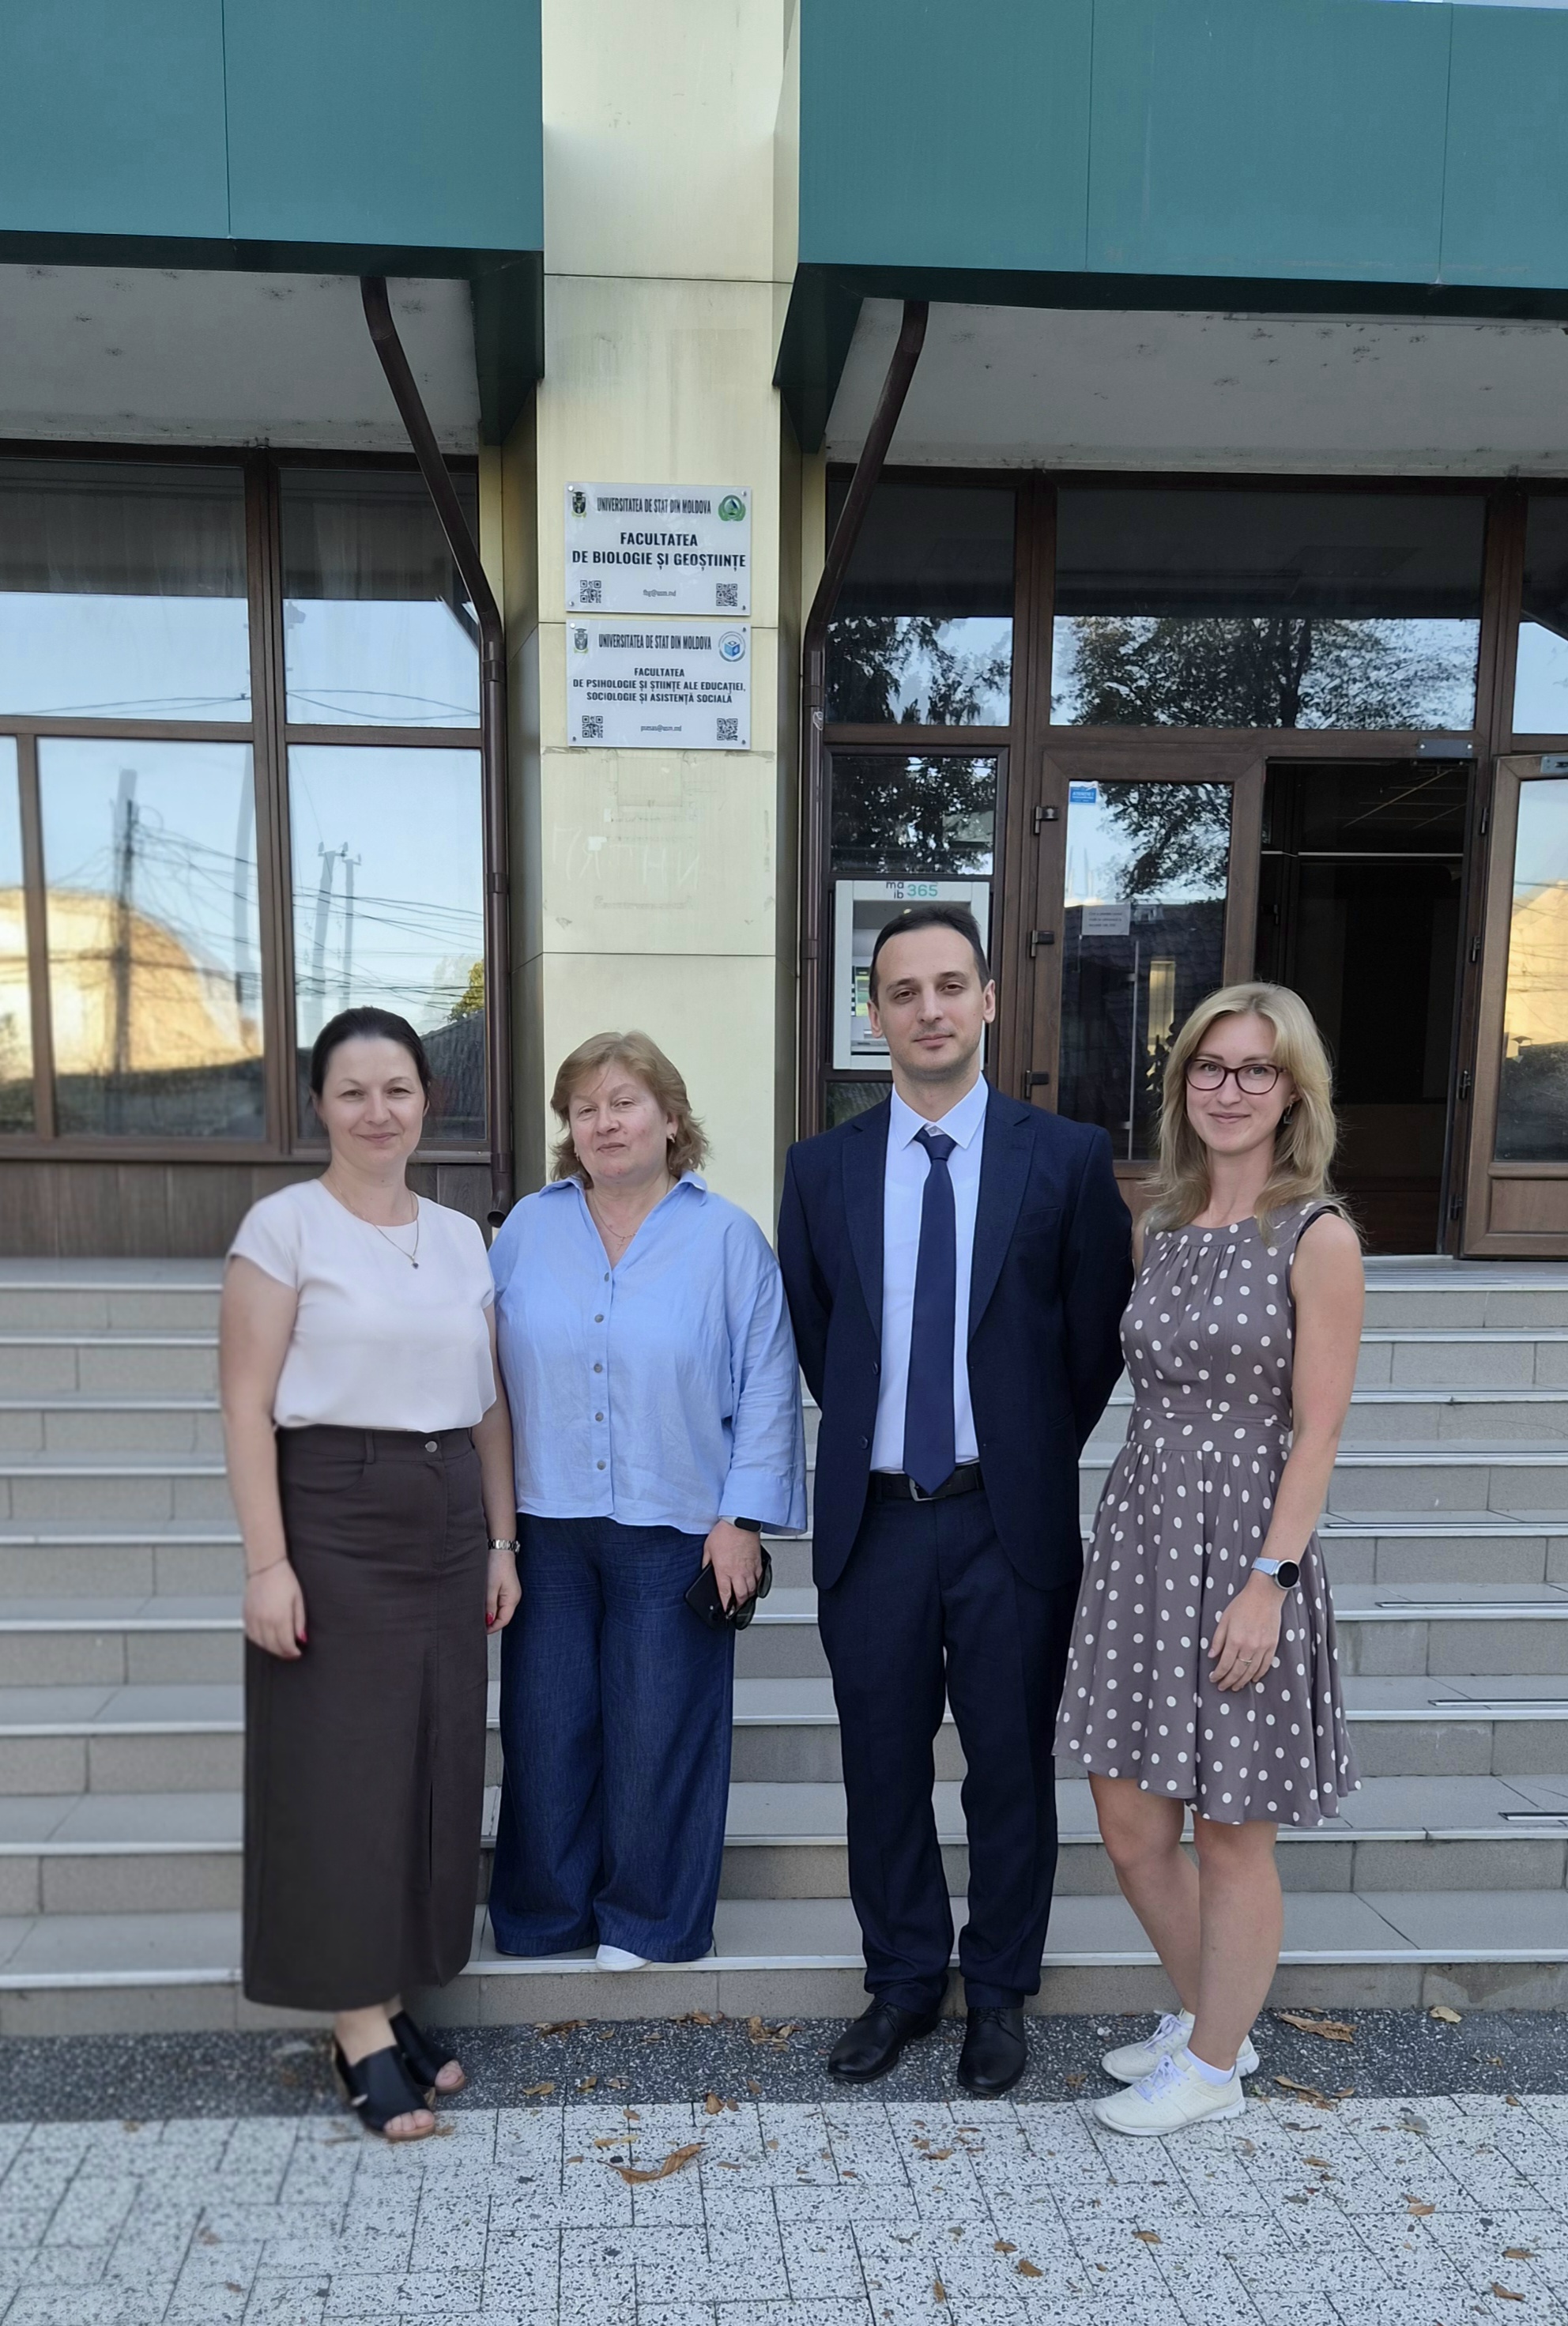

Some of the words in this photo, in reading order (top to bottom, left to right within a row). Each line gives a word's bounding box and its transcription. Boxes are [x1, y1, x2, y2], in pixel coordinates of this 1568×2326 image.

[597, 497, 643, 512] UNIVERSITATEA
[644, 499, 653, 513] DE
[654, 499, 669, 513] STAT
[669, 499, 680, 514] DIN
[682, 500, 711, 514] MOLDOVA
[620, 532, 698, 546] FACULTATEA
[572, 550, 589, 564] DE
[593, 551, 653, 565] BIOLOGIE
[657, 552, 669, 570] ȘI
[673, 553, 746, 572] GEOȘTIINȚE
[598, 633, 644, 648] UNIVERSITATEA
[645, 635, 654, 649] DE
[654, 635, 669, 649] STAT
[670, 635, 681, 649] DIN
[682, 635, 712, 650] MOLDOVA
[634, 667, 685, 677] FACULTATEA
[573, 679, 584, 688] DE
[586, 679, 637, 689] PSIHOLOGIE
[639, 680, 647, 692] ȘI
[650, 680, 681, 692] ȘTIINȚE
[683, 681, 699, 690] ALE
[700, 681, 746, 695] EDUCAȚIEI,
[586, 692, 637, 702] SOCIOLOGIE
[639, 692, 647, 704] ȘI
[650, 692, 695, 705] ASISTENȚĂ
[696, 693, 733, 703] SOCIALĂ
[906, 884, 938, 897] 365
